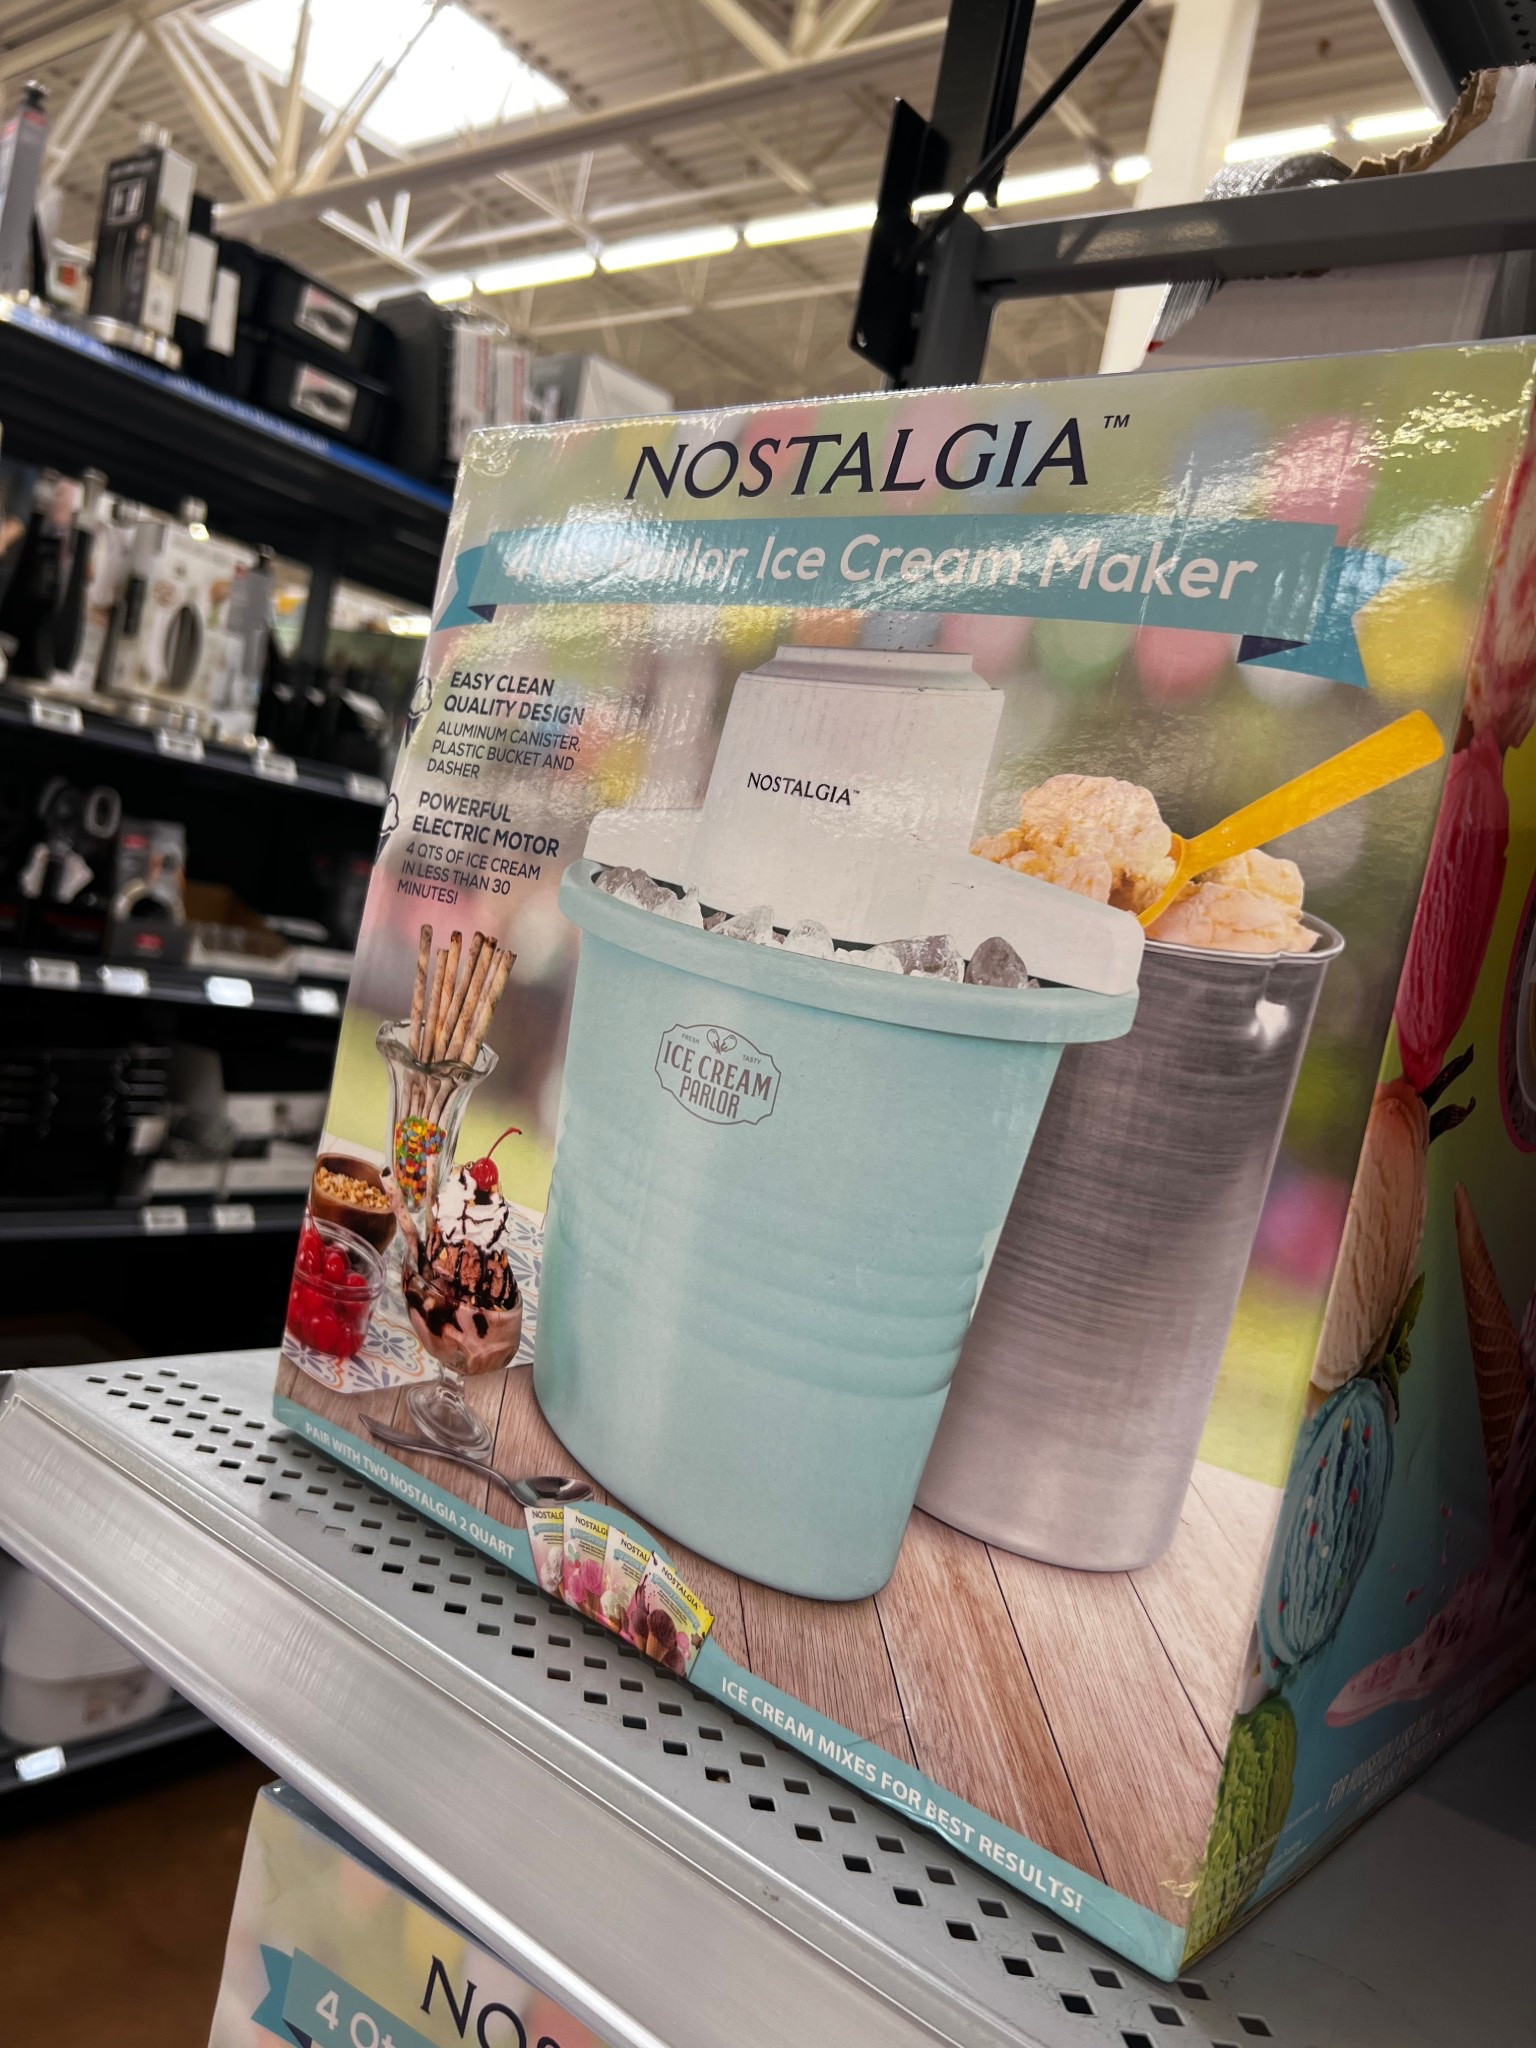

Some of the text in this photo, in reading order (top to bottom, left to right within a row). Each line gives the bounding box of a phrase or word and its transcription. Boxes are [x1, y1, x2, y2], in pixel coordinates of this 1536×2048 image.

[624, 417, 1089, 501] NOSTALGIA
[756, 535, 826, 580] Ice
[840, 534, 1022, 586] Cream
[1039, 536, 1259, 600] Maker
[450, 671, 555, 696] EASY CLEAN
[444, 695, 585, 726] QUALITY DESIGN
[437, 721, 507, 741] ALUMINUM
[427, 758, 480, 779] DASHER
[432, 740, 575, 771] PLASTIC BUCKET AND
[418, 791, 511, 823] POWERFUL
[747, 772, 851, 806] NOSTALGIA
[412, 815, 560, 857] ELECTRIC MOTOR
[401, 859, 511, 896] IN LESS THAN 30
[406, 841, 540, 880] 4 QTS OF ICE CREAM
[397, 879, 458, 905] MINUTES!
[663, 1040, 773, 1101] ICE CREAM
[679, 1075, 740, 1120] PARLOR
[305, 1422, 331, 1446] PAIR
[331, 1437, 361, 1466] WITH
[362, 1455, 388, 1482] TWO
[390, 1470, 458, 1527] NOSTALGIA
[459, 1516, 467, 1531] 2
[469, 1523, 515, 1560] QUART
[661, 1566, 698, 1610] NOSTALGIA
[722, 1676, 1084, 1914] ICE CREAM MIXES FOR BEST RESULTS!
[315, 1989, 340, 2031] 4
